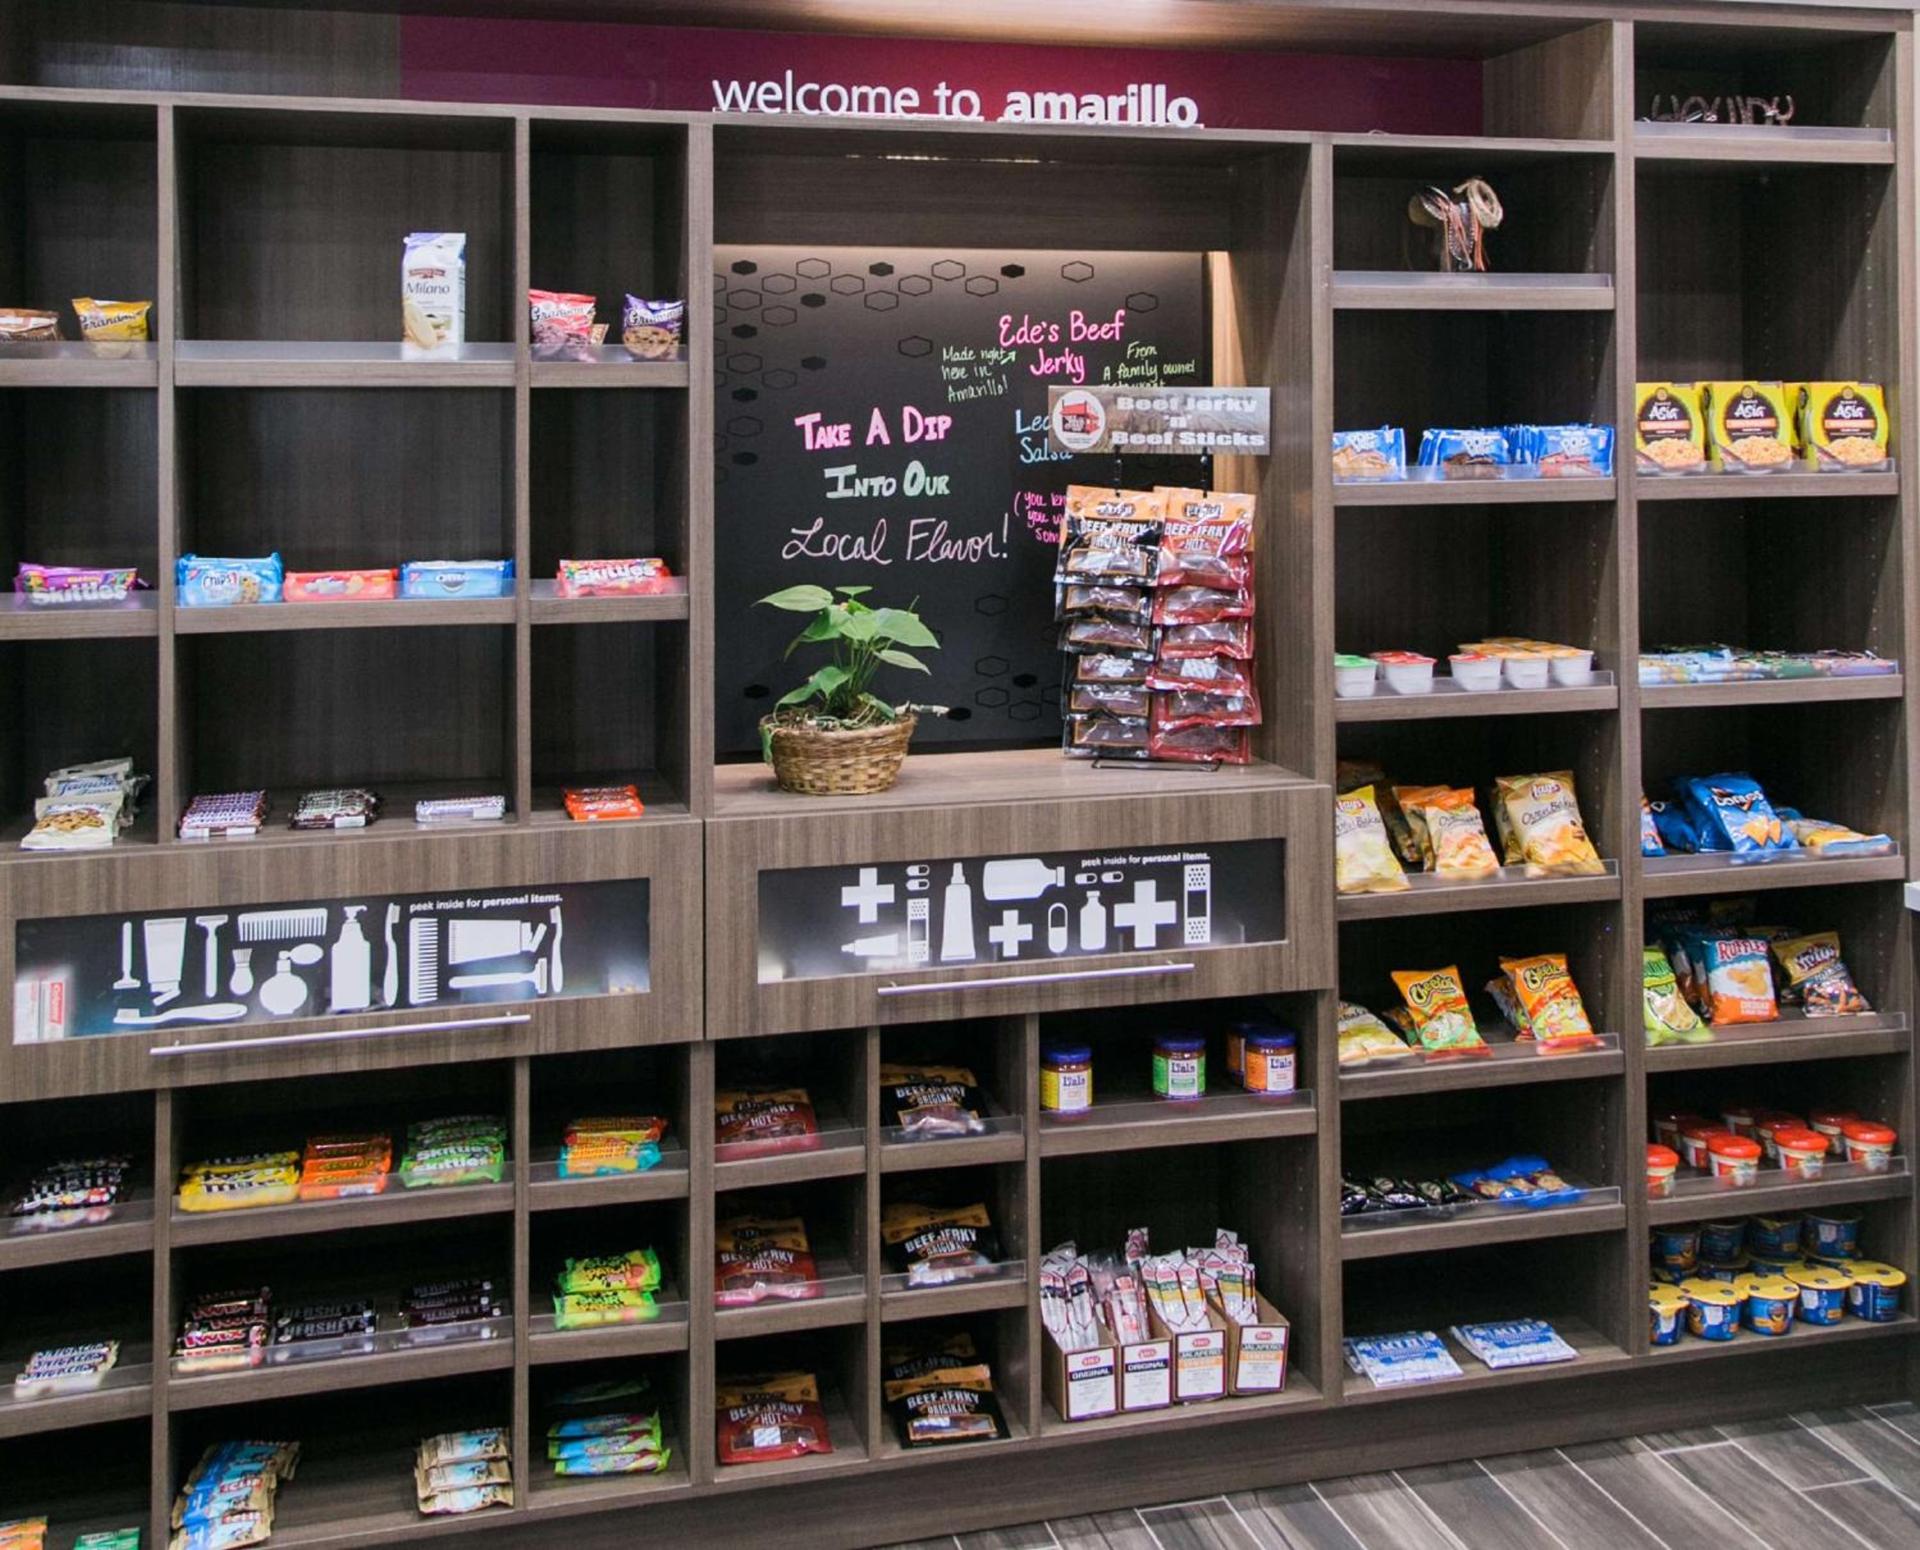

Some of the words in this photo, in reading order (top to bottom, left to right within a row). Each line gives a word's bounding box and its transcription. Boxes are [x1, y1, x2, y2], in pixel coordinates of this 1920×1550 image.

[711, 69, 921, 117] welcome
[932, 81, 981, 121] to
[1003, 82, 1199, 128] amarillo
[999, 313, 1060, 347] Ede's
[1070, 309, 1126, 342] Beef
[942, 345, 976, 362] Made
[980, 347, 1006, 365] right
[1126, 340, 1158, 359] From
[1030, 348, 1086, 383] Jerky
[1103, 365, 1111, 381] A
[1116, 359, 1158, 383] family
[1162, 359, 1196, 375] owned
[948, 373, 1009, 402] Amarillo!
[1116, 396, 1180, 411] Beef
[1184, 395, 1258, 413] Jerky
[794, 412, 851, 450] TAKE
[865, 407, 891, 446] A
[902, 405, 953, 443] DIP
[1111, 431, 1174, 446] Beef
[1178, 431, 1266, 447] Sticks
[823, 464, 897, 499] INTO
[902, 460, 950, 497] OUR
[782, 516, 893, 565] Local
[906, 512, 1009, 563] Flavor!
[1164, 521, 1194, 536] BEEF
[31, 580, 128, 606] Skittles
[1080, 857, 1102, 869] peek
[1102, 856, 1127, 866] inside
[1128, 854, 1142, 864] for
[1141, 852, 1182, 866] personal
[409, 901, 434, 914] peek
[435, 899, 465, 910] inside
[466, 898, 481, 908] for
[482, 894, 529, 909] personal
[530, 893, 563, 904] items.
[750, 1114, 773, 1127] HOT
[904, 1232, 937, 1253] BEEF
[938, 1227, 978, 1243] JERKY
[751, 1260, 774, 1270] HOT
[1071, 1367, 1111, 1380] ORIGINAL
[1127, 1361, 1166, 1372] ORIGINAL
[906, 1394, 937, 1410] BEEF
[939, 1390, 980, 1405] JERKY
[729, 1404, 762, 1422] BEEF
[762, 1401, 804, 1415] JERKY
[760, 1412, 783, 1426] HOT
